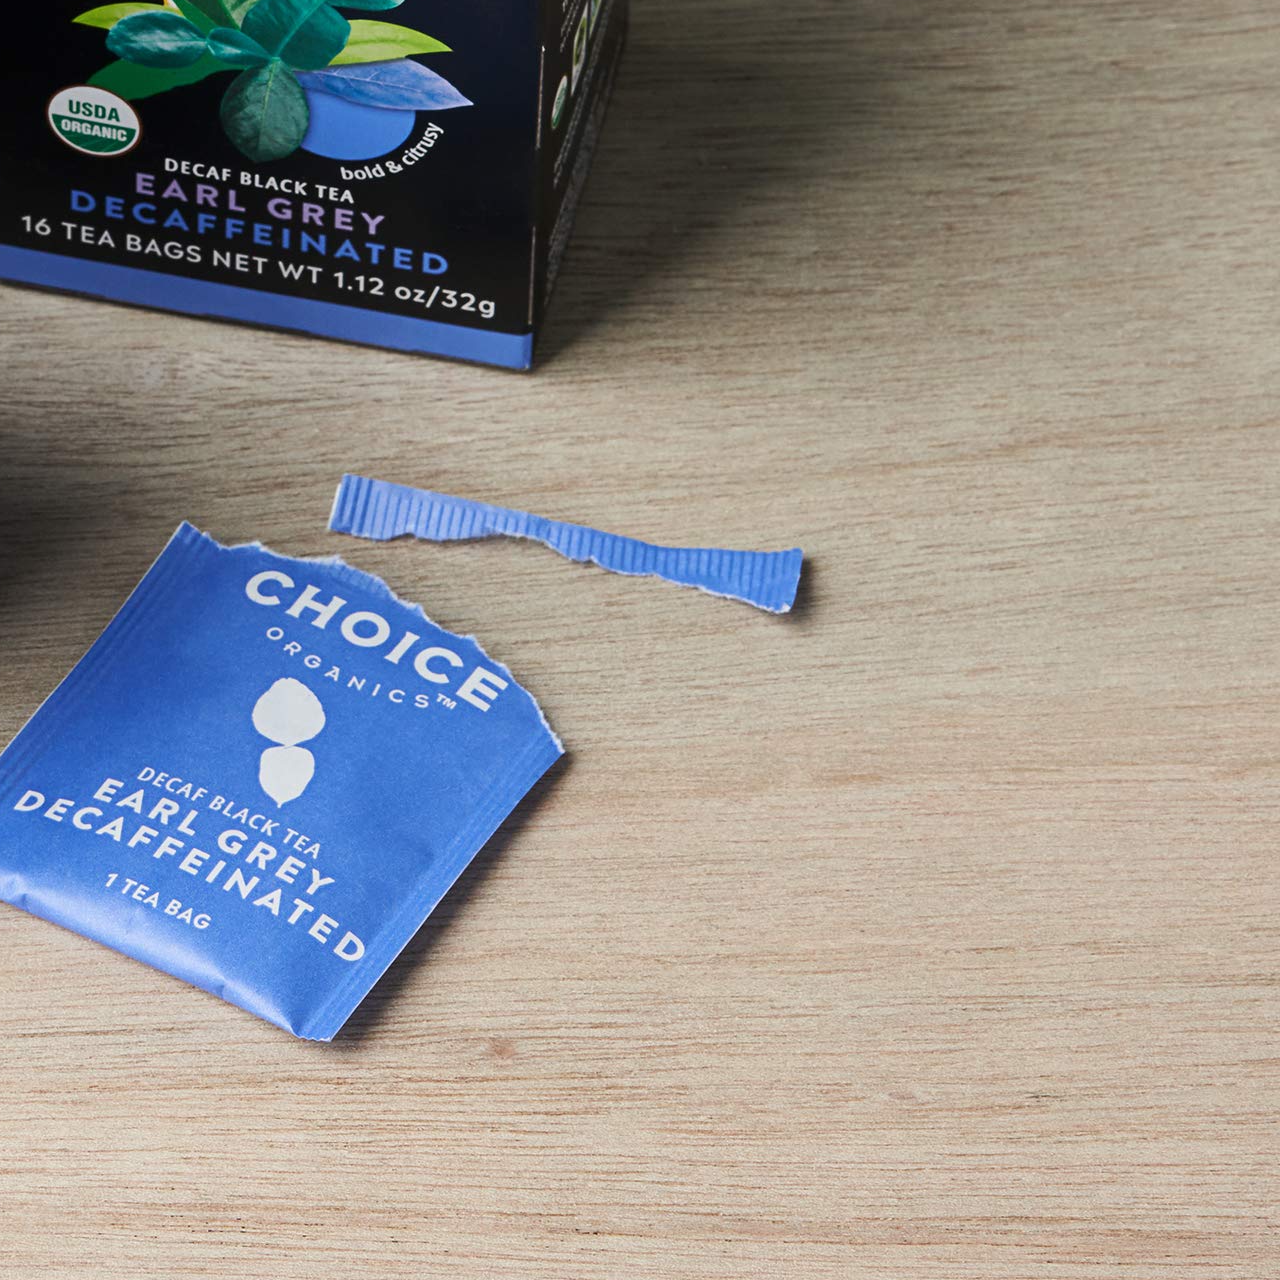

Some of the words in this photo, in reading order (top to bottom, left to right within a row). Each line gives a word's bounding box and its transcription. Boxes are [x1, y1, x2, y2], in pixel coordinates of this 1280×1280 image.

[61, 119, 127, 142] ORGANIC
[68, 99, 121, 122] USDA
[164, 157, 232, 183] DECAF
[240, 171, 308, 197] BLACK
[315, 184, 354, 205] TEA
[340, 163, 386, 180] bold
[385, 161, 403, 173] &
[402, 122, 444, 165] citrusy
[71, 189, 449, 275] DECAFFEINATED
[135, 172, 246, 213] EARL
[267, 197, 385, 235] GREY
[21, 215, 52, 237] 16
[62, 221, 116, 249] TEA
[127, 234, 202, 264] BAGS
[213, 250, 268, 275] NET
[278, 262, 324, 286] WT
[333, 270, 384, 297] 1.12
[394, 285, 497, 320] oz/32g
[244, 570, 509, 713] CHOICE
[92, 777, 197, 836] EARL
[217, 828, 336, 896] GREY
[137, 766, 208, 802] DECAF
[209, 793, 282, 838] BLACK
[283, 826, 323, 860] TEA
[13, 789, 366, 962] DECAFFEINATED
[105, 873, 117, 889] 1
[118, 878, 160, 912] TEA
[164, 897, 212, 930] BAG
